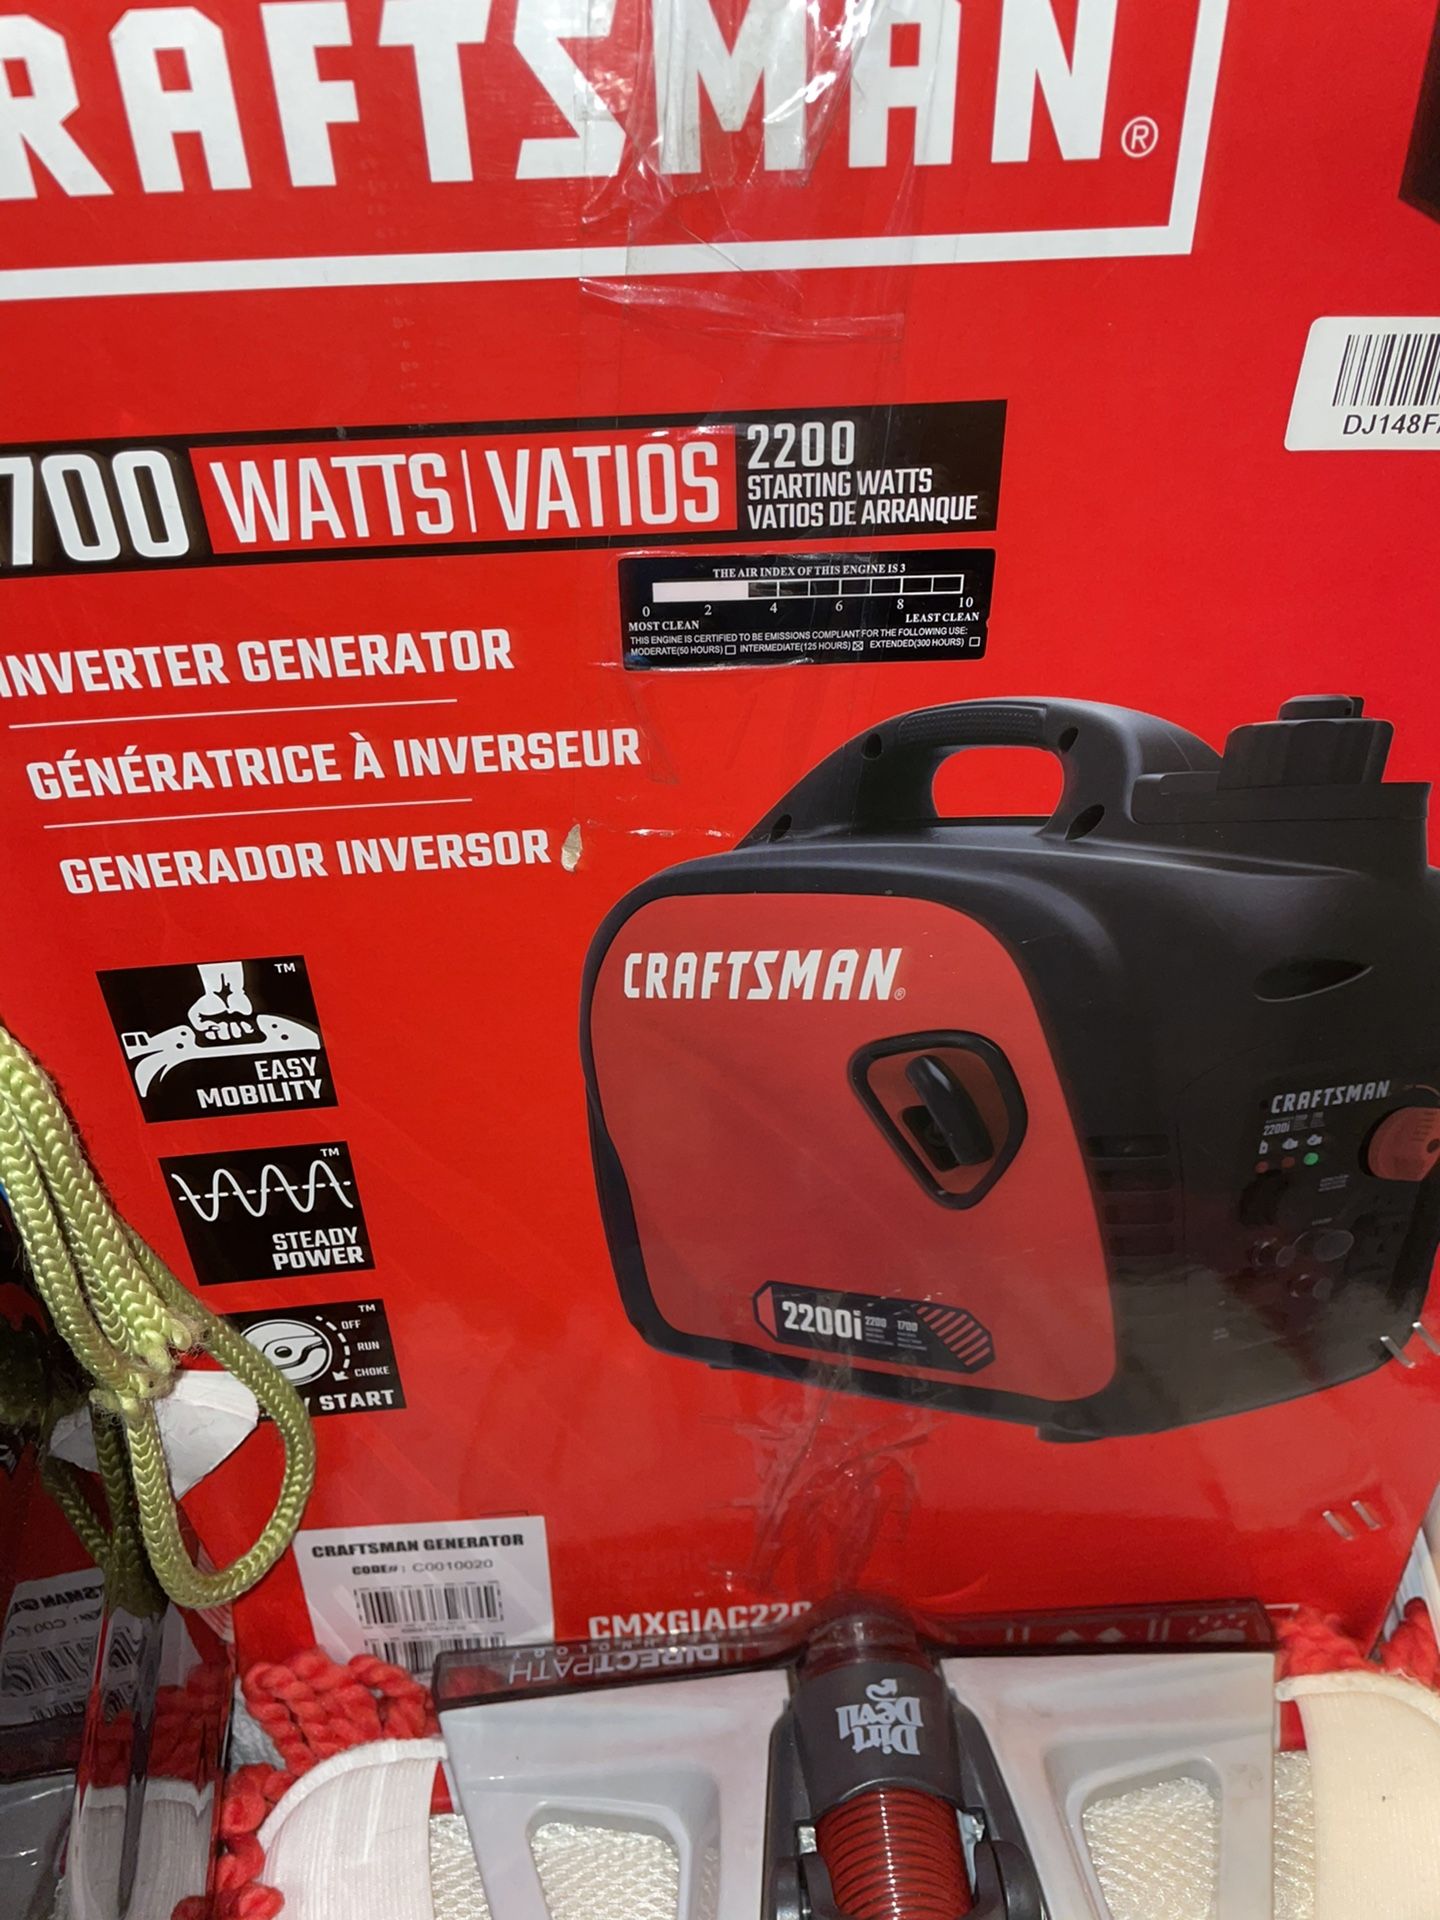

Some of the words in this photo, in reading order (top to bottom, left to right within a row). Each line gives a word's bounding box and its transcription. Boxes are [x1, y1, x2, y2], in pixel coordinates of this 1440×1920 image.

[1343, 414, 1440, 435] DJ148F
[747, 420, 855, 469] 2200
[209, 452, 454, 543] WATTS
[484, 441, 720, 532] VATIOS
[747, 471, 851, 500] STARTING
[856, 468, 932, 496] WATTS
[747, 503, 824, 530] VATIOS
[829, 501, 857, 526] DE
[861, 495, 979, 525] ARRANQUE
[713, 568, 738, 579] THE
[738, 567, 758, 578] AIR
[760, 566, 796, 578] INDEX
[797, 566, 813, 576] OF
[814, 565, 841, 575] THIS
[843, 564, 886, 574] ENGINE
[888, 563, 899, 574] IS
[900, 563, 907, 573] 3
[642, 605, 650, 617] 0
[704, 604, 713, 616] 2
[769, 602, 778, 613] 4
[835, 600, 843, 612] 6
[896, 598, 904, 610] 8
[959, 597, 974, 608] 10
[905, 612, 942, 623] LEAST
[942, 611, 980, 622] CLEAN
[628, 622, 660, 632] MOST
[661, 620, 700, 631] CLEAN
[630, 636, 649, 645] THIS
[651, 635, 683, 644] ENGINE
[684, 634, 692, 643] IS
[694, 633, 737, 643] CERTIFIED
[739, 632, 751, 642] TO
[752, 632, 763, 641] BE
[764, 630, 811, 641] EMISSIONS
[812, 629, 860, 639] COMPLIANT
[861, 628, 879, 638] FOR
[880, 627, 897, 637] THE
[898, 626, 948, 637] FOLLOWING
[948, 626, 968, 636] USE:
[0, 643, 230, 698] INVERTER
[236, 628, 515, 682] GENERATOR
[26, 743, 342, 800] GÉNÉRATRICE
[349, 731, 386, 780] À
[393, 728, 642, 778] INVERSEUR
[59, 842, 329, 895] GENERADOR
[336, 829, 552, 876] INVERSOR
[624, 948, 903, 1000] CRAFTSMAN
[255, 1056, 318, 1082] EASY
[196, 1079, 323, 1108] MOBILITY
[1270, 1080, 1391, 1114] CRAFTSMAN
[272, 1226, 358, 1251] STEADY
[272, 1245, 365, 1271] POWER
[341, 1320, 361, 1330] OFF
[782, 1300, 863, 1341] 2200i
[356, 1341, 380, 1352] RUN
[354, 1366, 390, 1377] CHOKE
[319, 1389, 394, 1411] START
[312, 1539, 419, 1558] CRAFTSMAN
[423, 1534, 525, 1551] GENERATOR
[834, 1696, 924, 1740] Devil
[851, 1724, 921, 1755] Dirt
